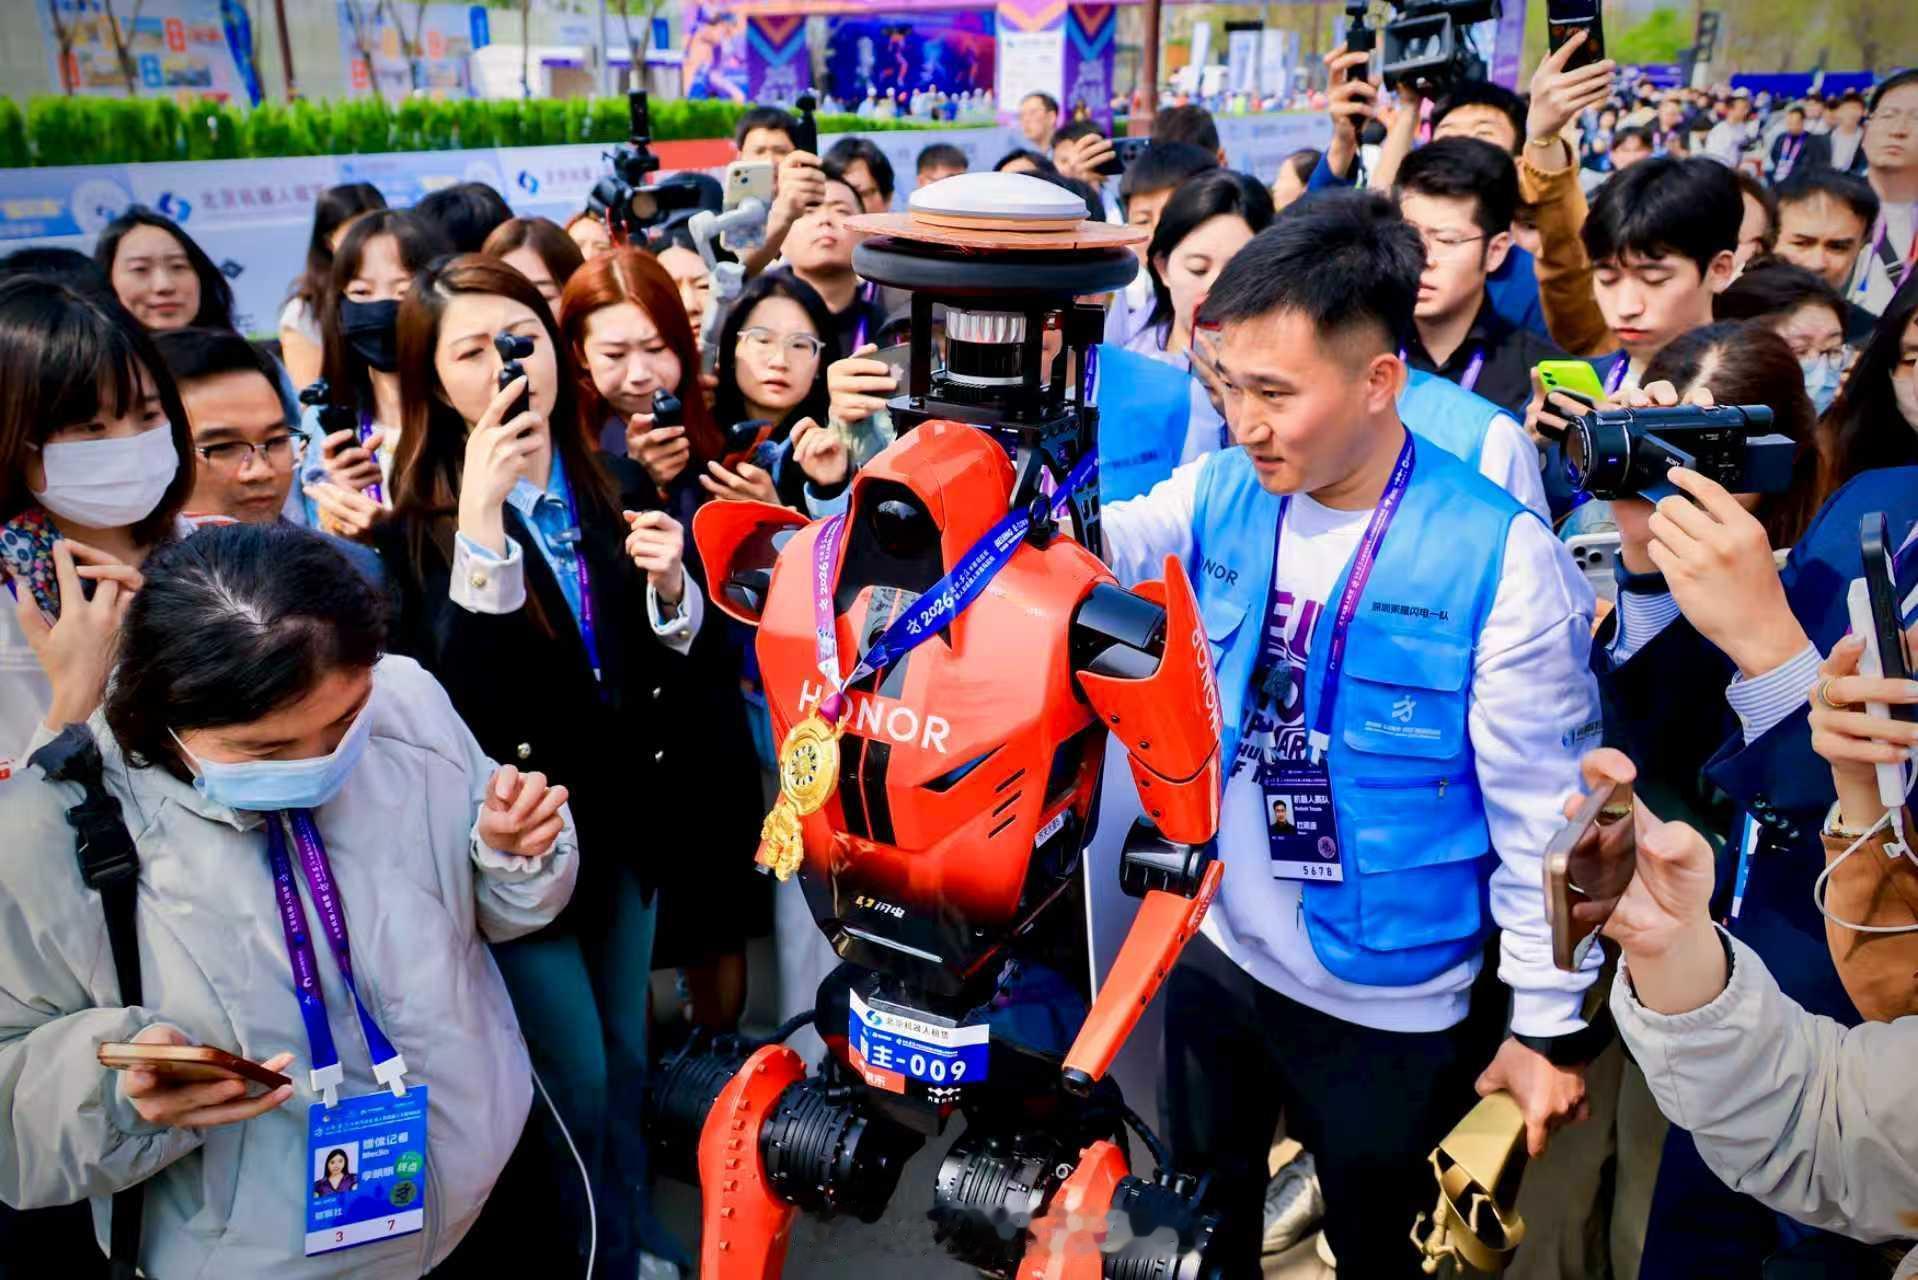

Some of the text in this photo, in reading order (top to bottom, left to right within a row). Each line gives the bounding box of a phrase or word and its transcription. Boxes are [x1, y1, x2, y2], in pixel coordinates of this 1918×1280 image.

[920, 592, 954, 627] 2026
[388, 1219, 396, 1231] 7
[335, 1231, 344, 1242] 3
